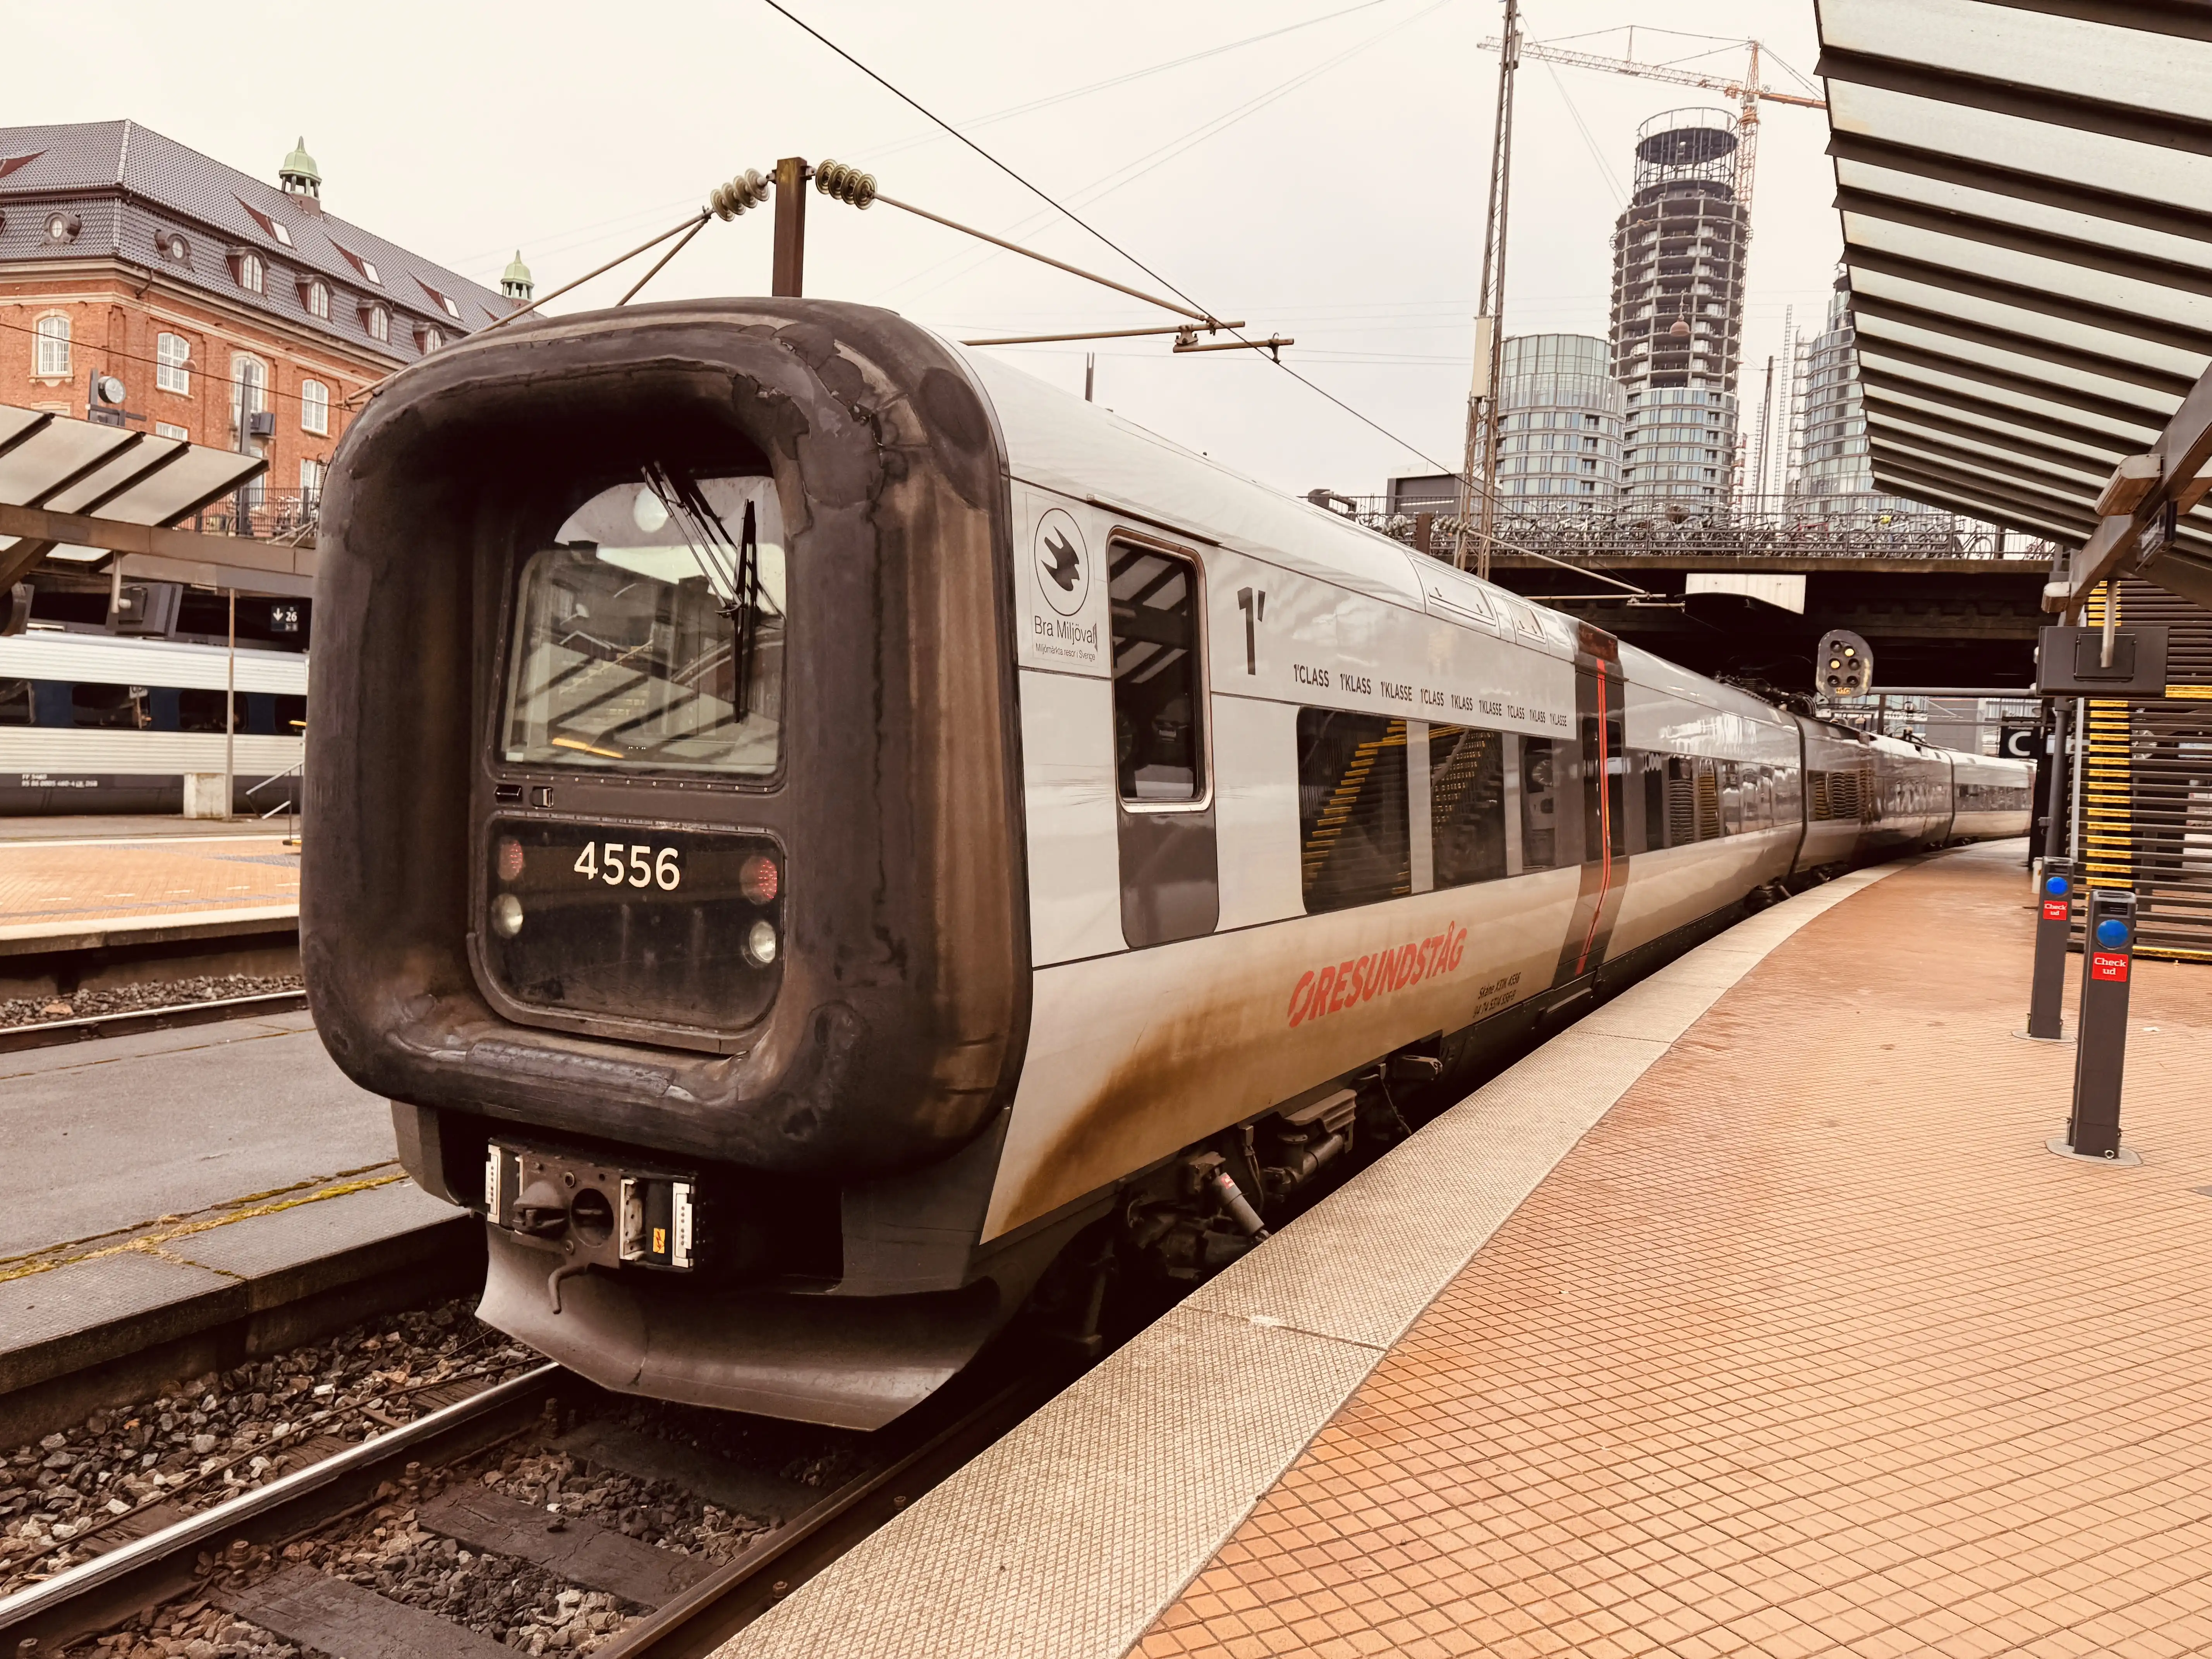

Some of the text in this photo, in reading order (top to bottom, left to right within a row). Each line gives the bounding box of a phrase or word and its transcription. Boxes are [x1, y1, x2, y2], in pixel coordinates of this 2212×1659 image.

[285, 611, 297, 622] 26
[1034, 615, 1096, 645] Bra Miljöval
[2008, 731, 2032, 756] C
[574, 842, 680, 890] 4556
[2094, 957, 2127, 967] Check
